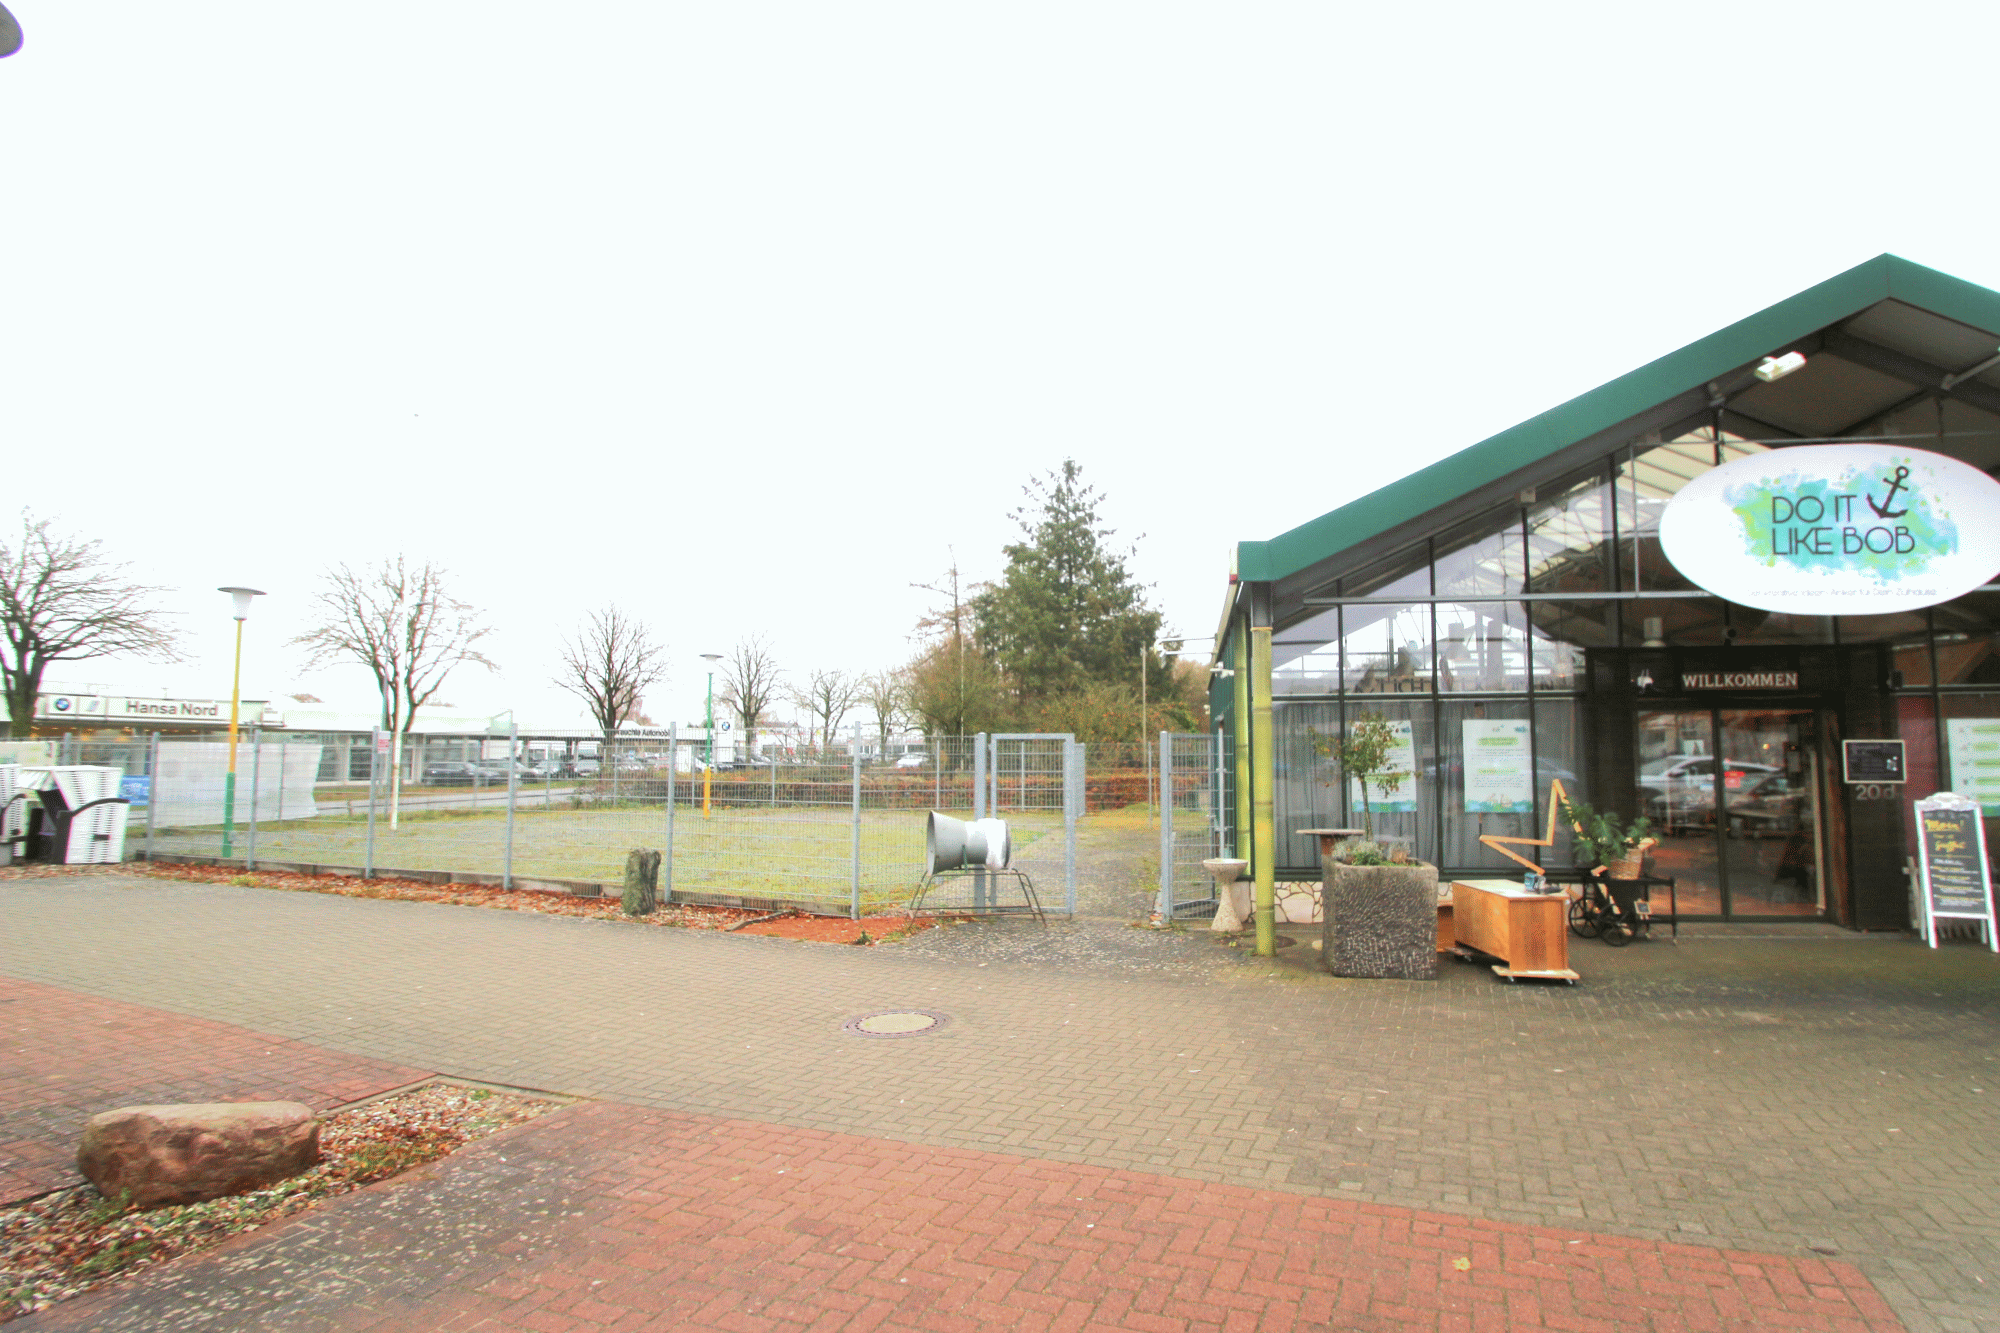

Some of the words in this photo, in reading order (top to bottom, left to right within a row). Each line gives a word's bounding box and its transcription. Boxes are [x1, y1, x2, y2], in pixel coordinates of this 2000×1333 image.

[1772, 495, 1825, 523] DO
[1834, 494, 1858, 523] IT
[1771, 526, 1834, 556] LIKE
[1842, 525, 1916, 555] BOB
[1682, 672, 1798, 689] WILLKOMMEN
[126, 700, 177, 715] Hansa
[181, 703, 218, 716] Nord
